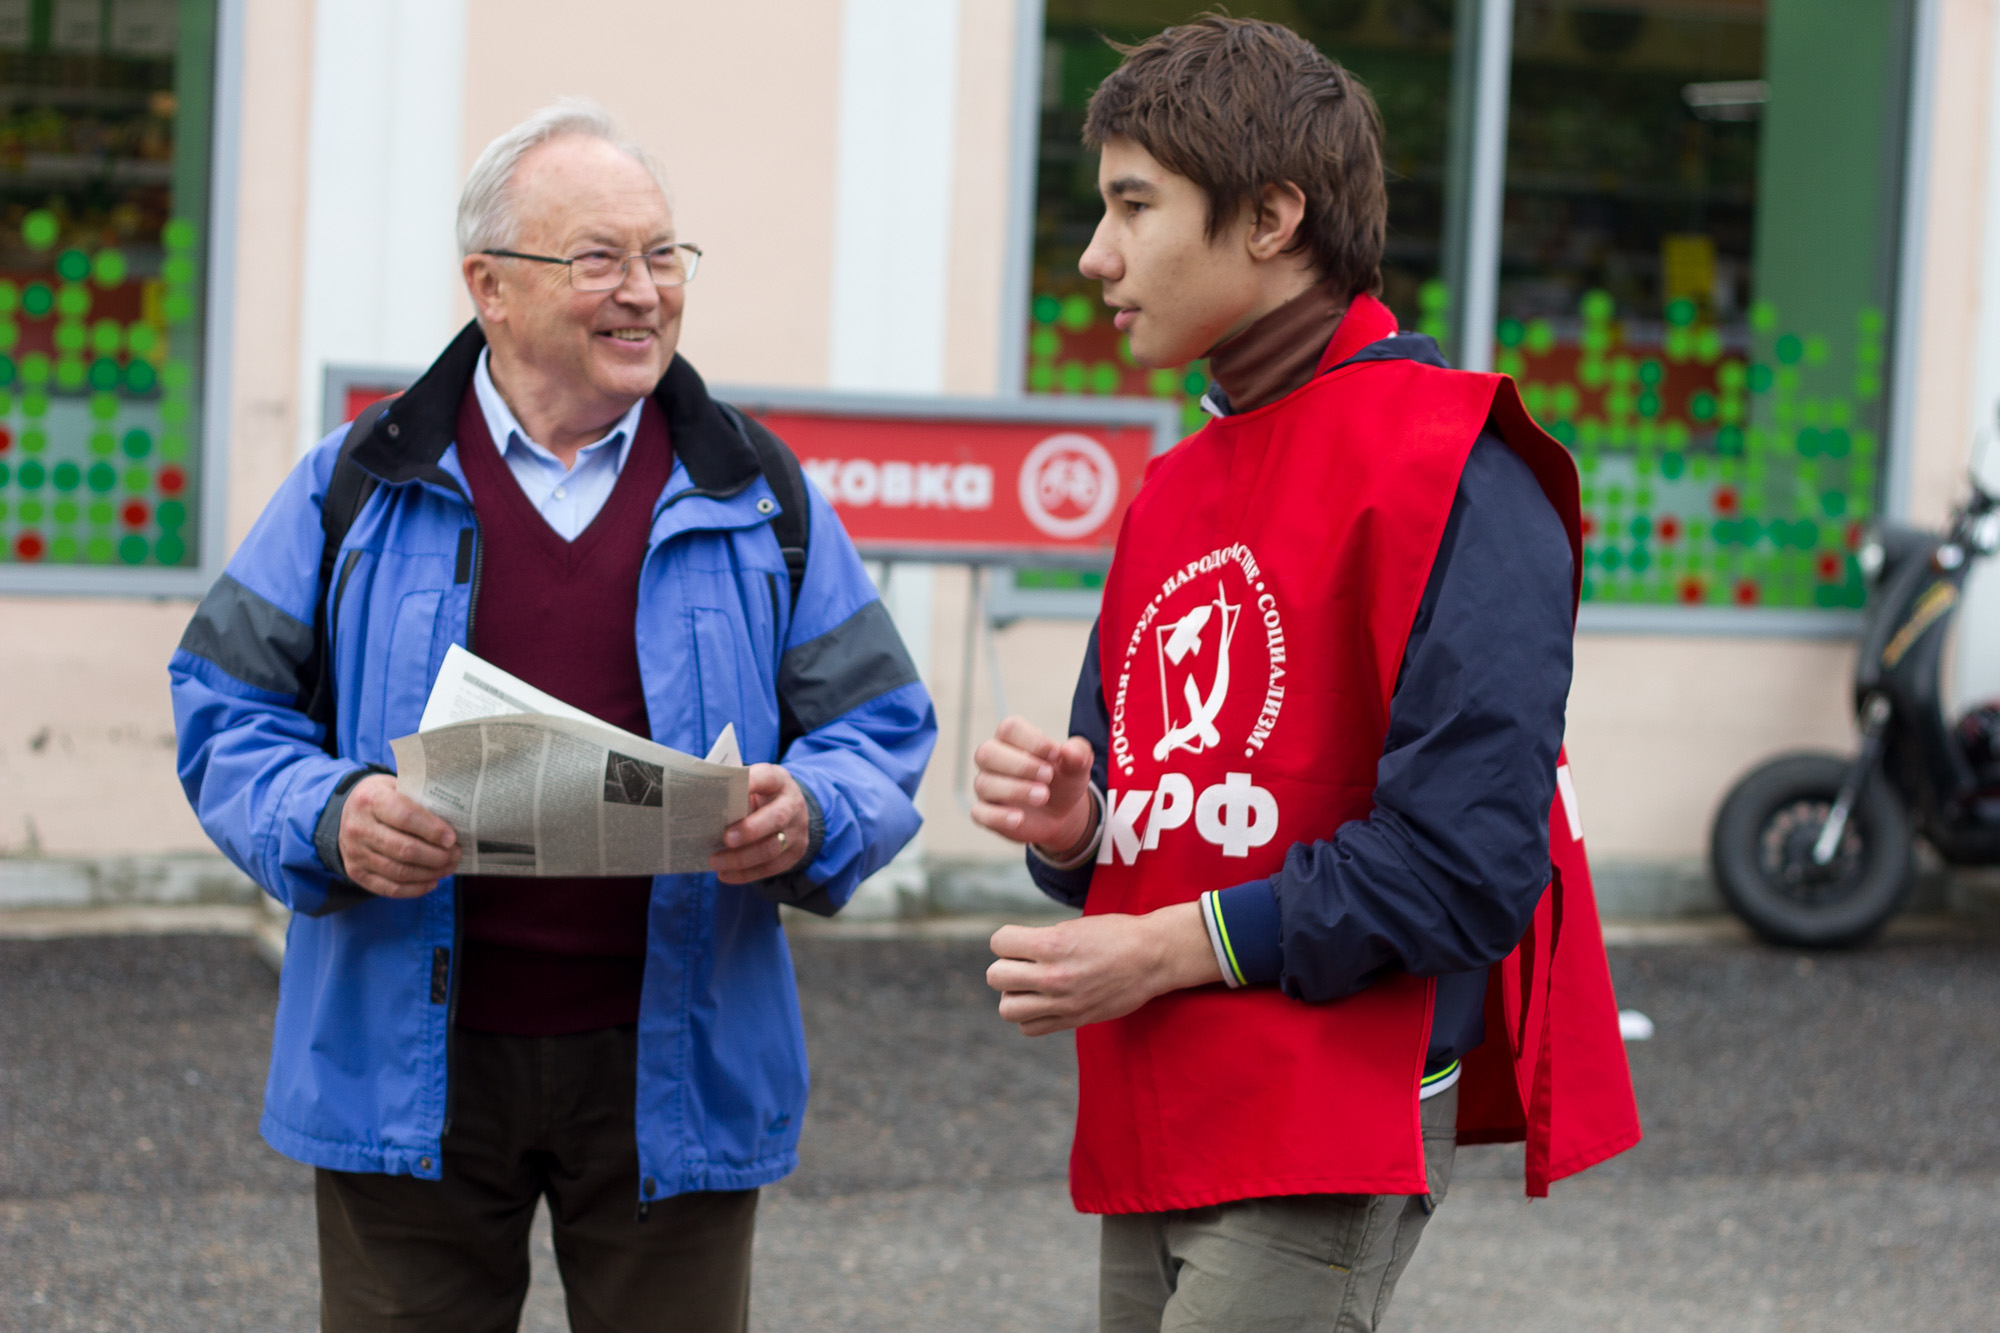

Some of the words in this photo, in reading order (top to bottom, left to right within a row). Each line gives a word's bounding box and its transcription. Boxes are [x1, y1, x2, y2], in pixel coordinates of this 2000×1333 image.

[1111, 673, 1135, 768] РОССИЯ
[1126, 601, 1160, 657] ТРУД
[1246, 593, 1287, 751] СОЦИАЛИЗМ
